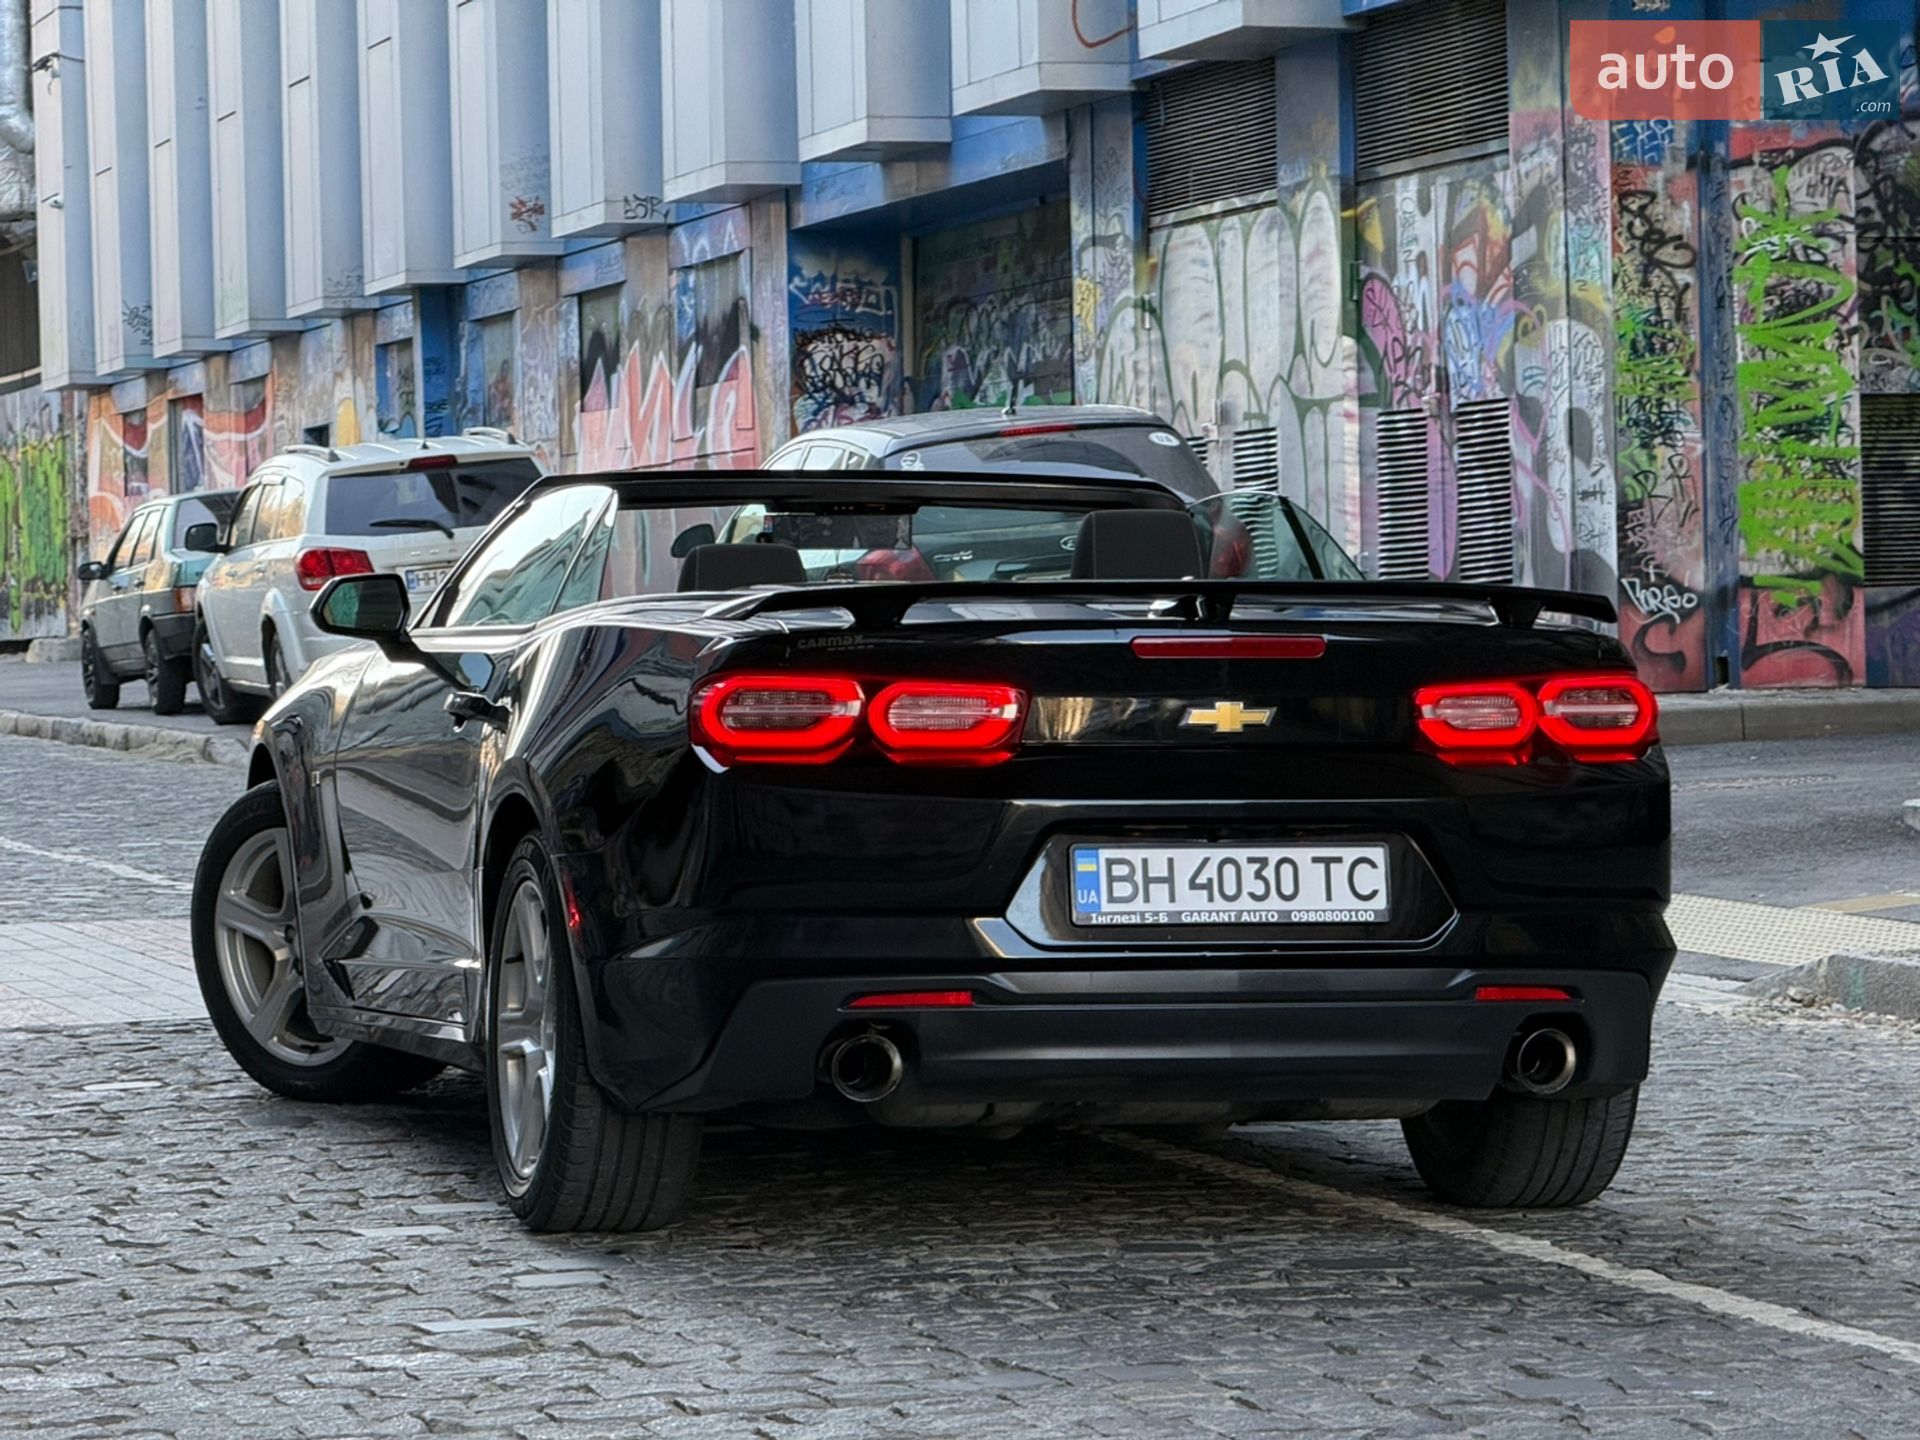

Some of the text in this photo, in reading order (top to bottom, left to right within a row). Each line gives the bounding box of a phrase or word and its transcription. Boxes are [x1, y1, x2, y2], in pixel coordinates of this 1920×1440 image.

[1104, 856, 1380, 904] BH 4030 TC
[1077, 889, 1098, 904] UA
[1181, 910, 1375, 923] GARANT AUTO 0980800100
